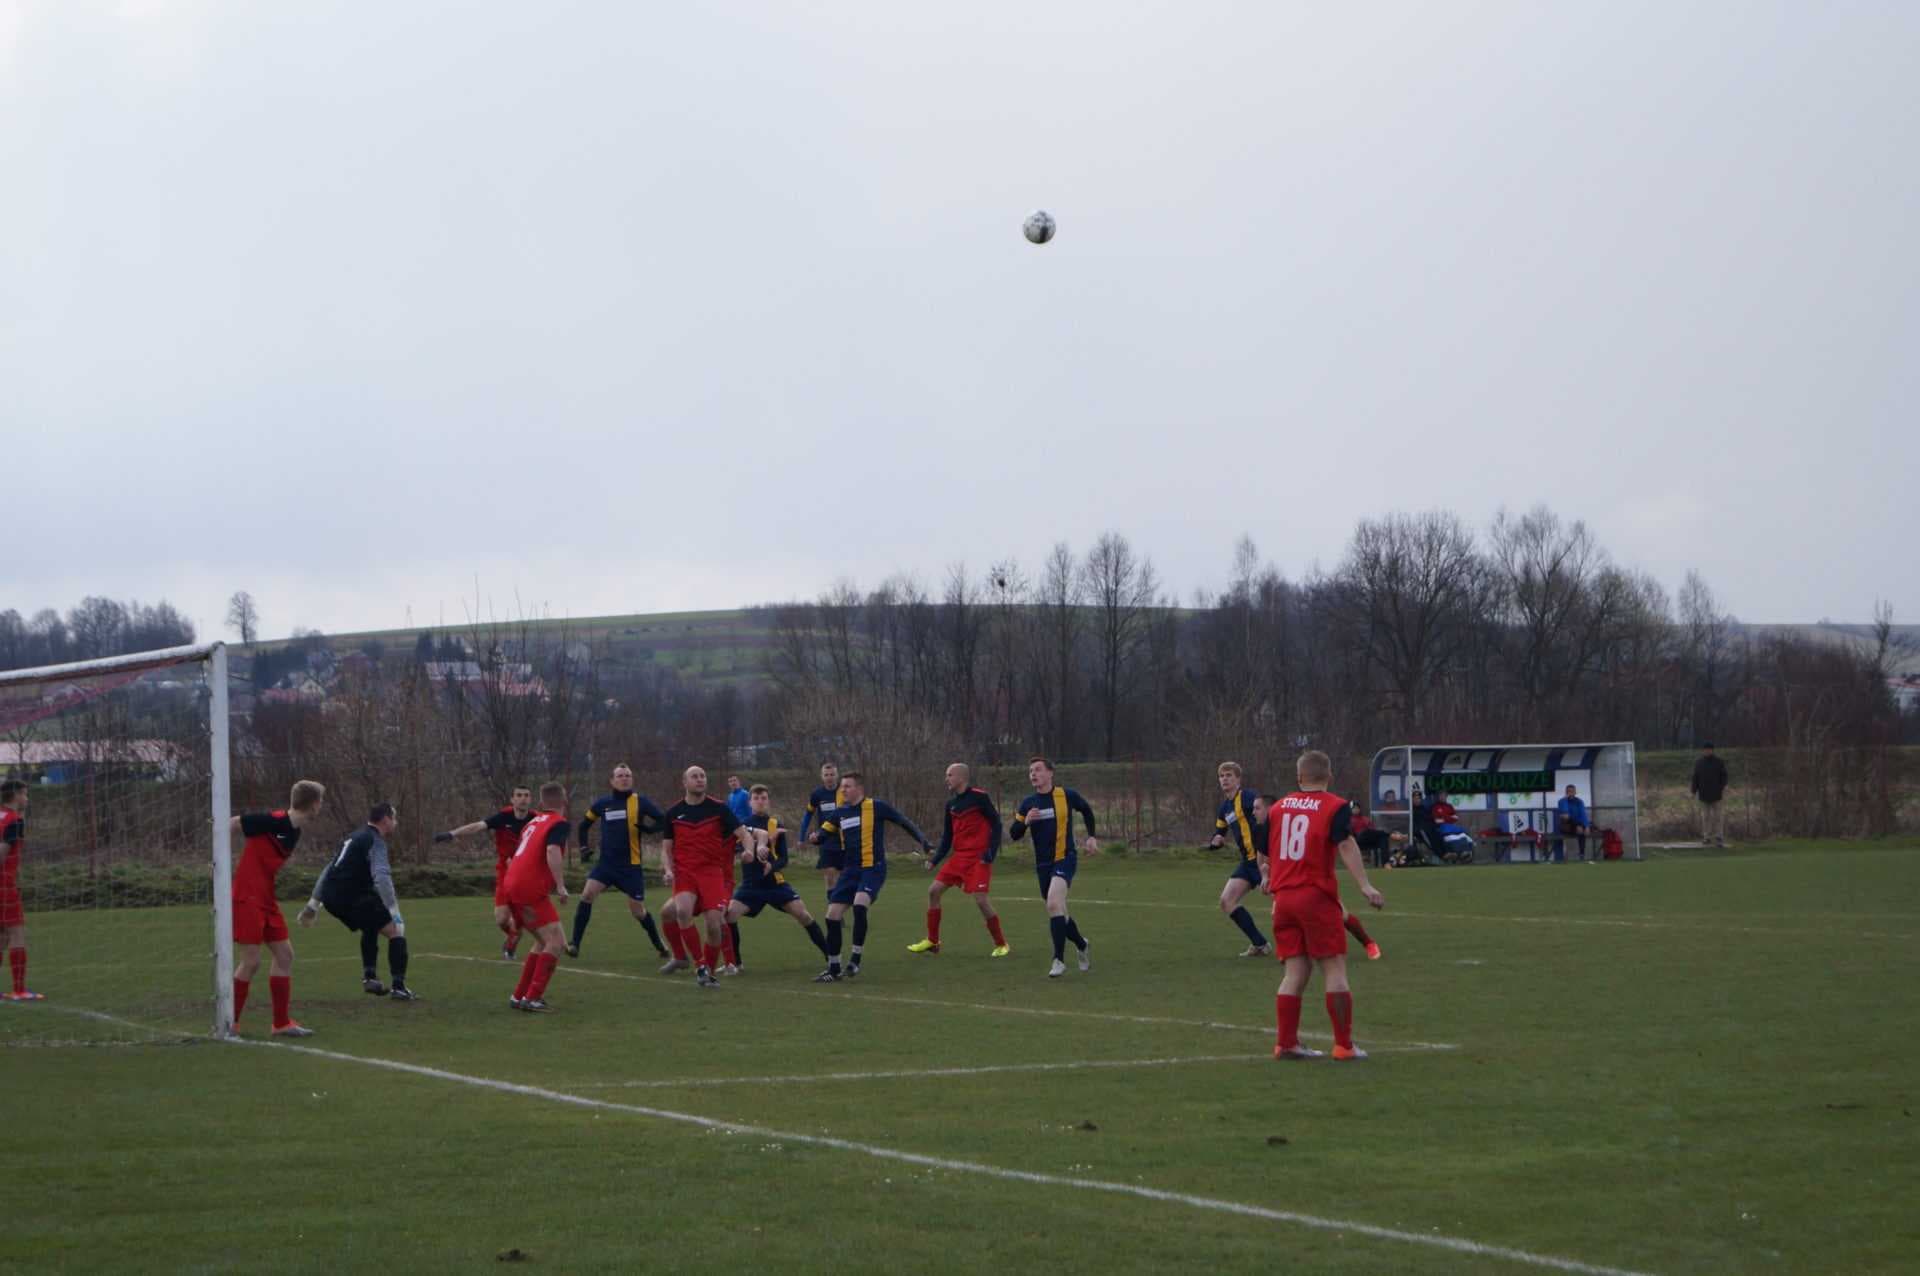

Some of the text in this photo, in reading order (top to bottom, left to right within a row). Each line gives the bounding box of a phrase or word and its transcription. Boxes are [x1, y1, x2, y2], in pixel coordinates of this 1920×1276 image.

[1429, 773, 1551, 789] GOSPODARZE
[1281, 796, 1322, 811] STRAŻAK
[1280, 813, 1310, 861] 18
[334, 838, 353, 867] 1
